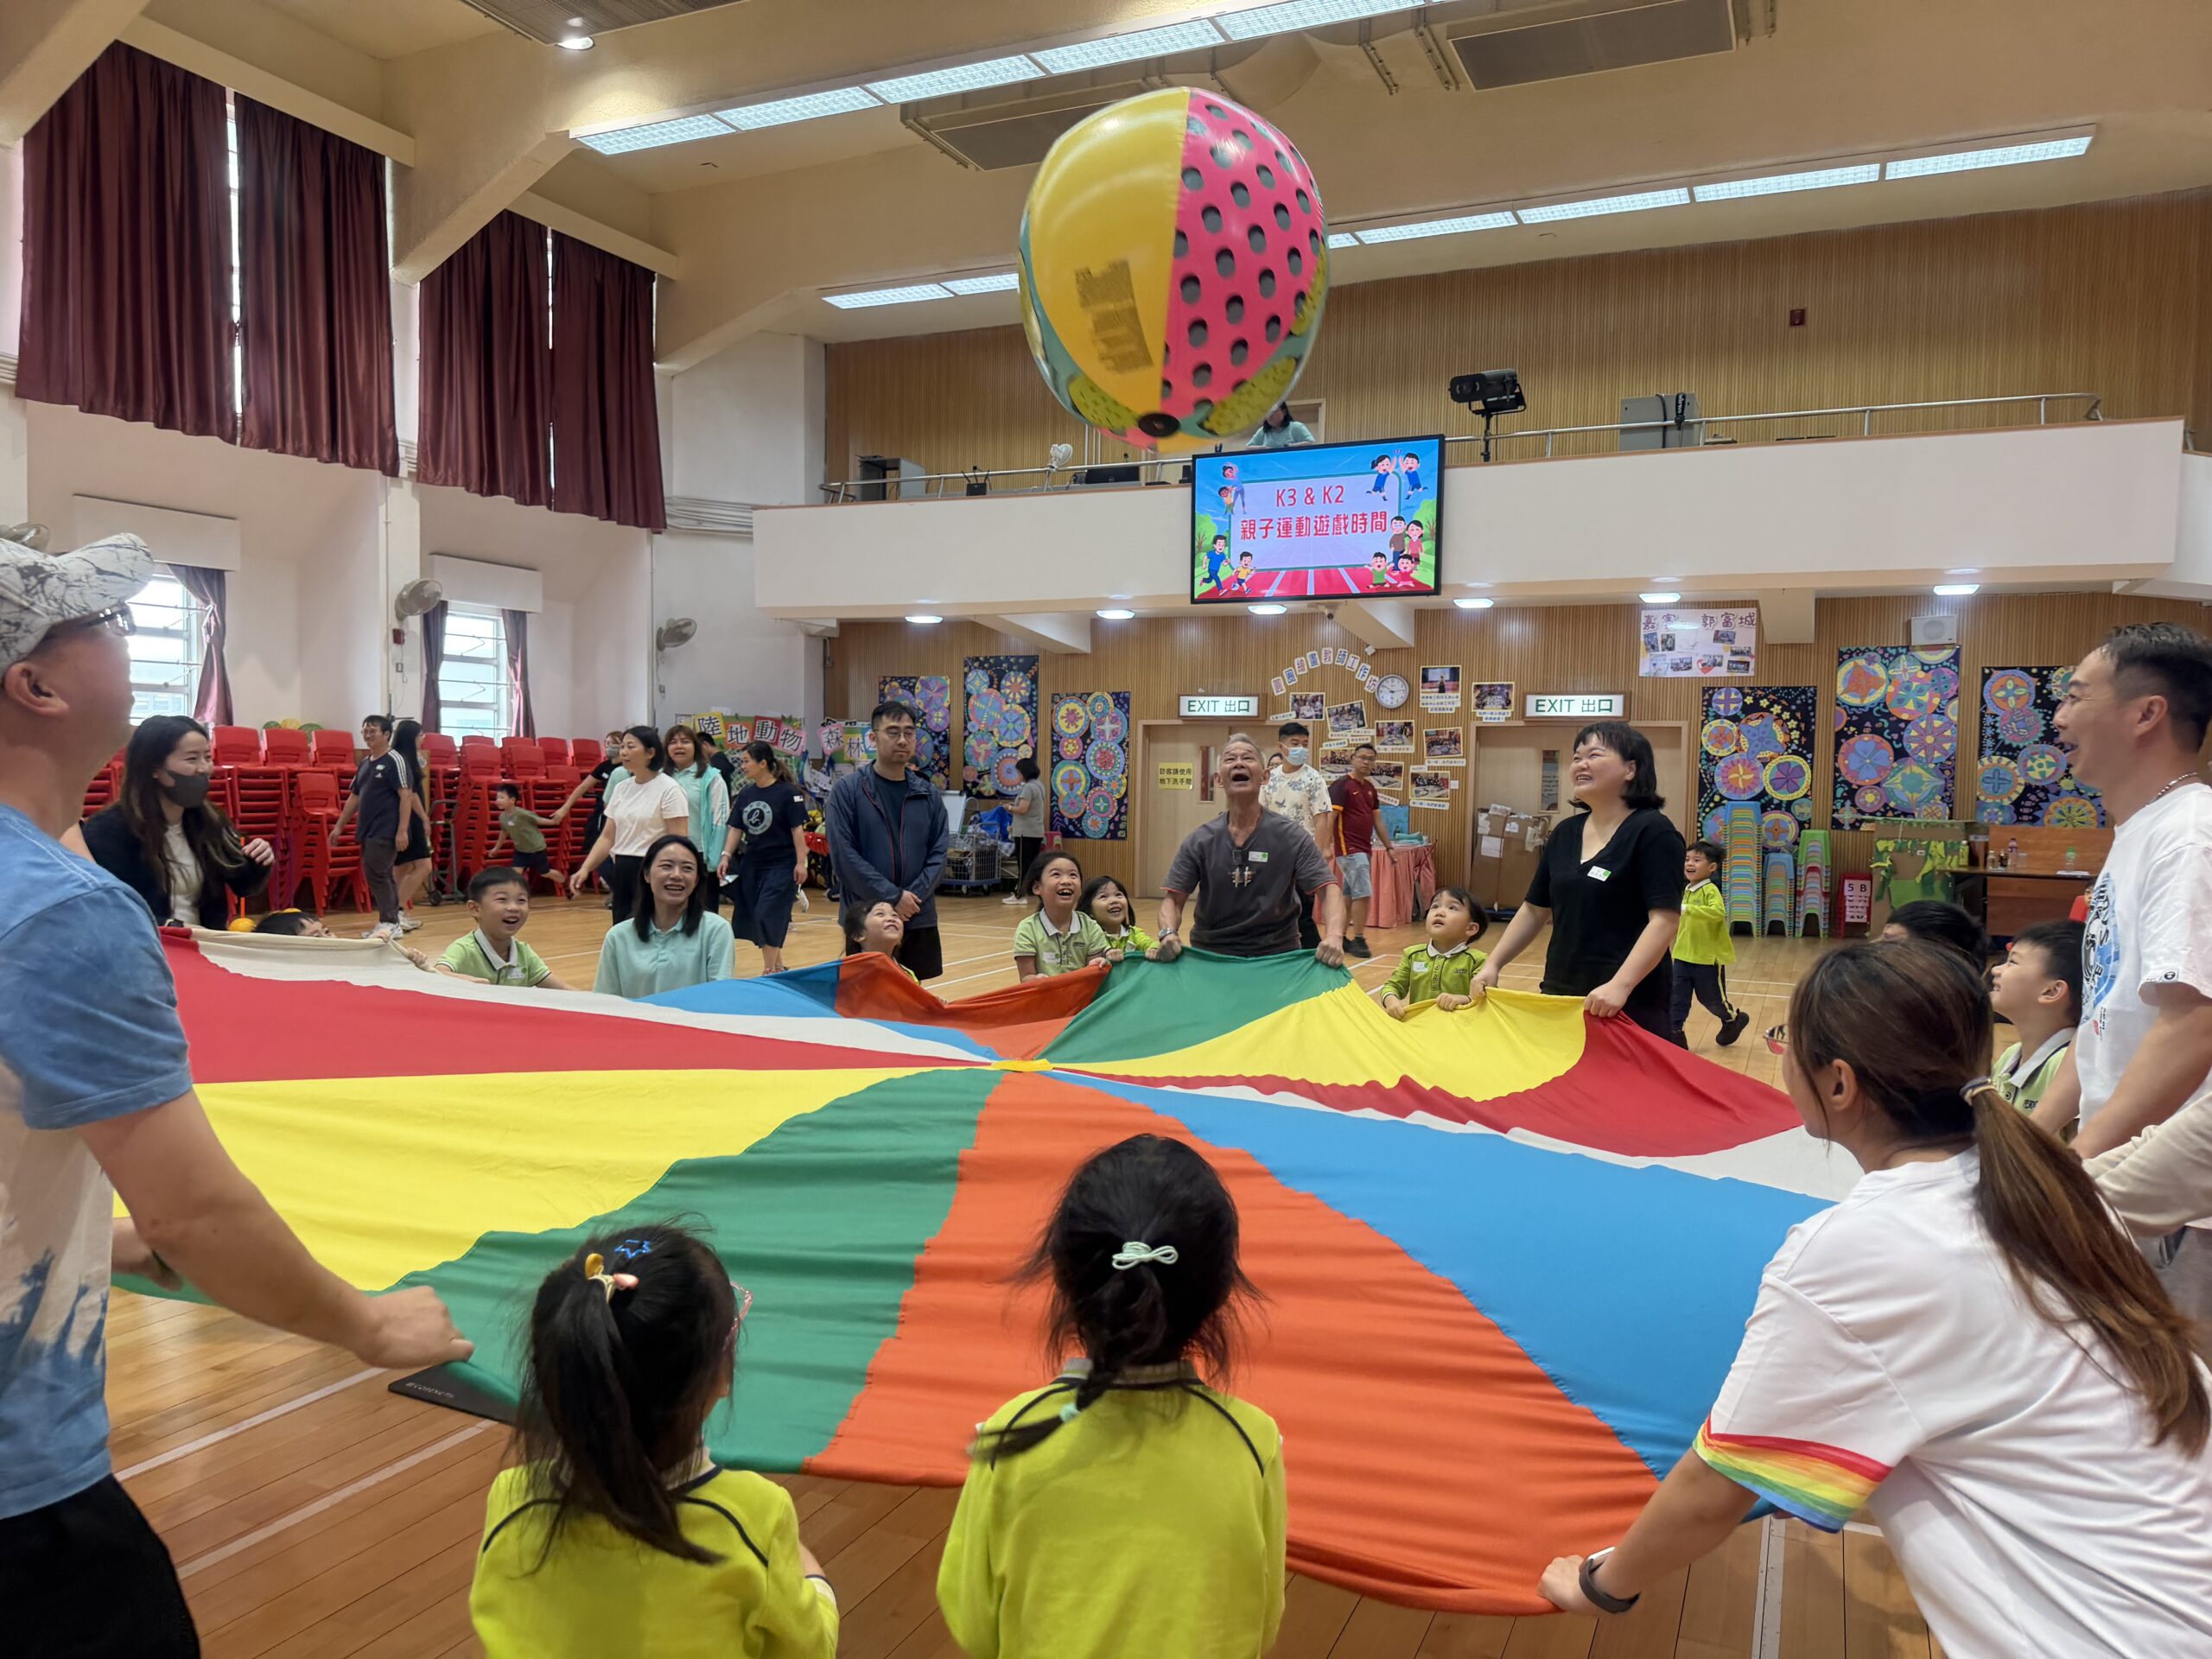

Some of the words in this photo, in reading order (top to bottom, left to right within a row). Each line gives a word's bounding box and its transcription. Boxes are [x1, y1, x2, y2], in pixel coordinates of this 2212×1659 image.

[1276, 488, 1297, 507] K3
[1304, 486, 1315, 505] &
[1322, 485, 1344, 505] K2
[1241, 512, 1388, 540] 親子運動遊戲時間
[1700, 612, 1756, 628] 郭富城
[1188, 700, 1219, 712] EXIT
[1224, 700, 1249, 712] 出口
[1535, 699, 1574, 712] EXIT
[1581, 699, 1612, 712] 出口
[698, 716, 802, 752] 陸地動物
